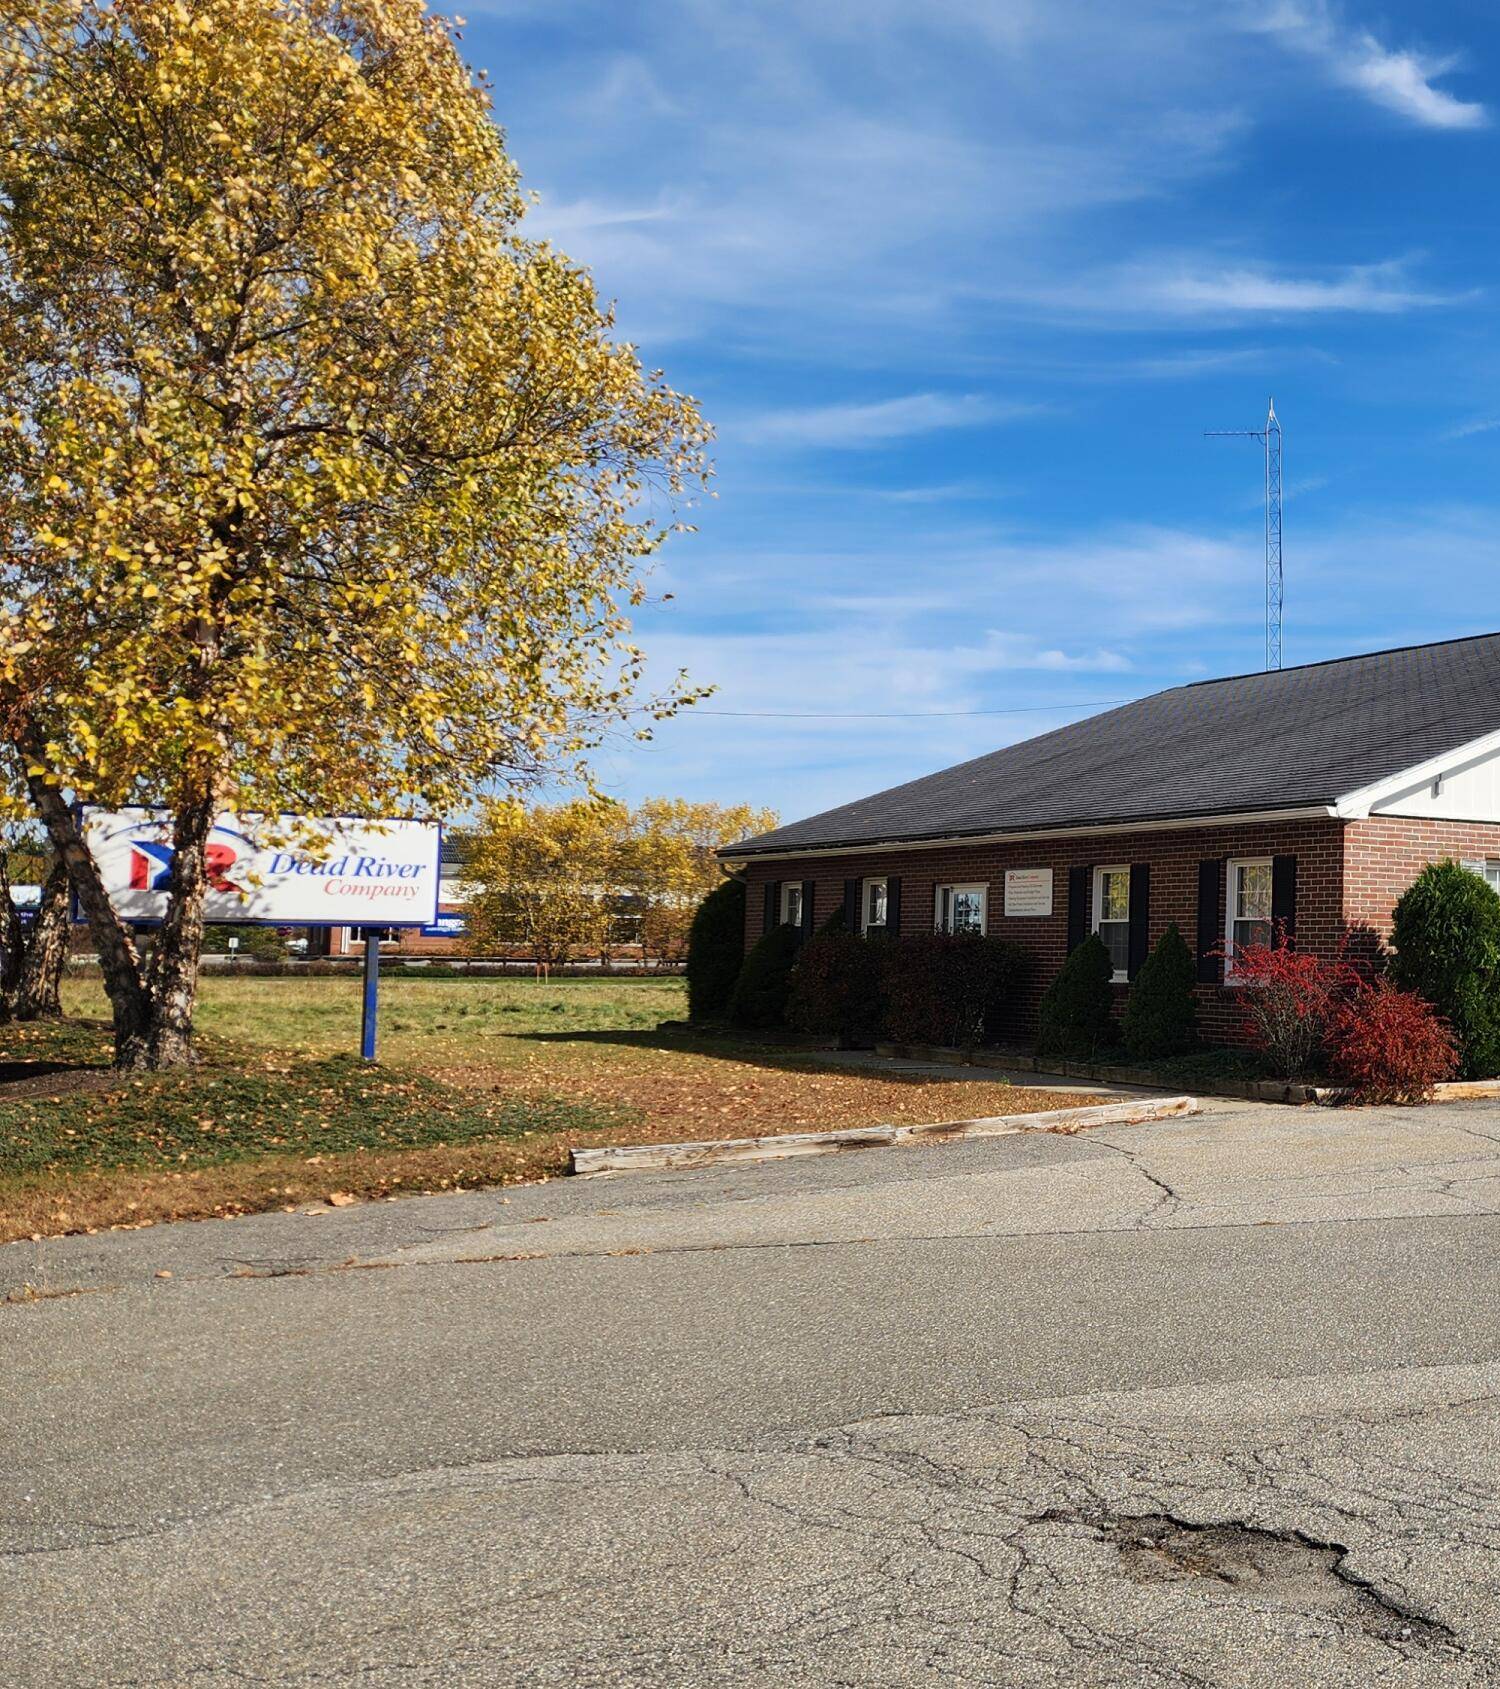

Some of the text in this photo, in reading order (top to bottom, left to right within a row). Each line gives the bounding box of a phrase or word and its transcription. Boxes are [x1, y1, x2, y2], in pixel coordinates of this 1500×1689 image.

[267, 852, 427, 879] Dead River
[323, 878, 420, 901] Company
